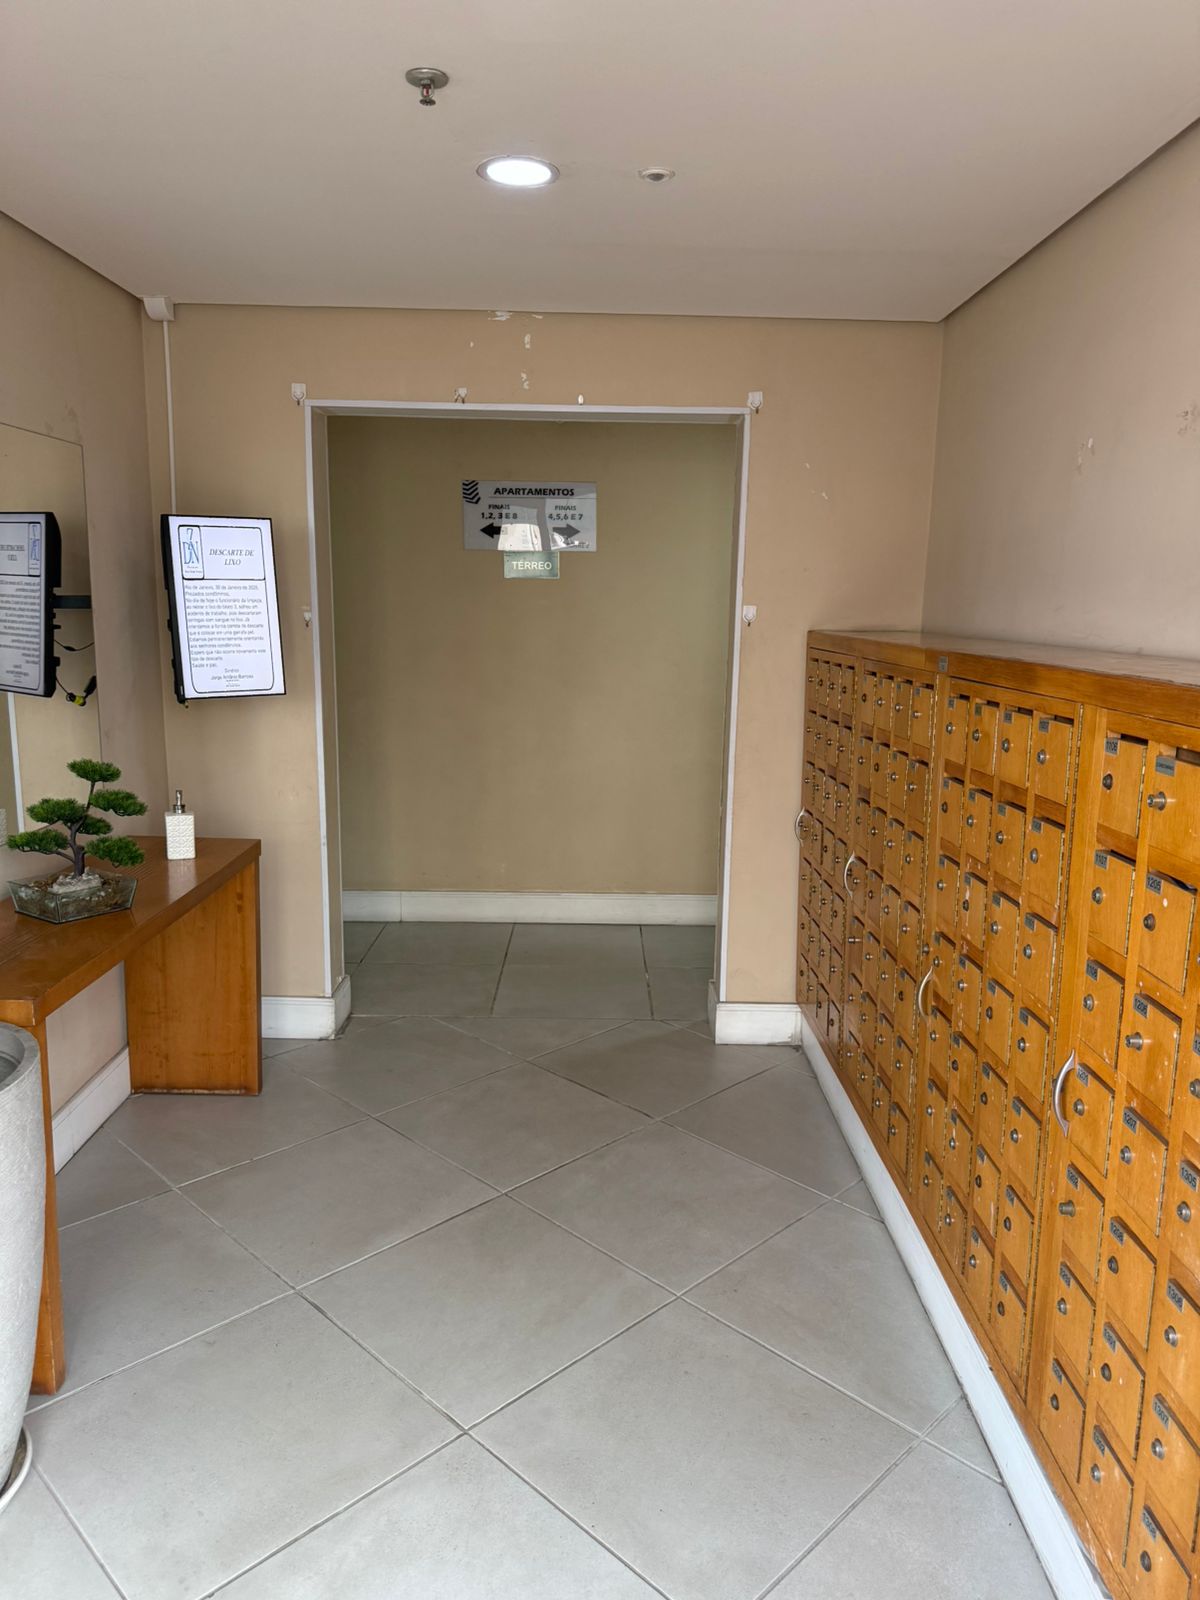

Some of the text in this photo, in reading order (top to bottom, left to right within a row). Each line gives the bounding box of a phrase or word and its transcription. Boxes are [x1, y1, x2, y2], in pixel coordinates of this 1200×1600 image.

[494, 487, 575, 496] APARTAMENTOS
[209, 548, 255, 557] DESCARTE DE
[223, 558, 242, 566] LIXO
[1181, 1166, 1198, 1189] 1305
